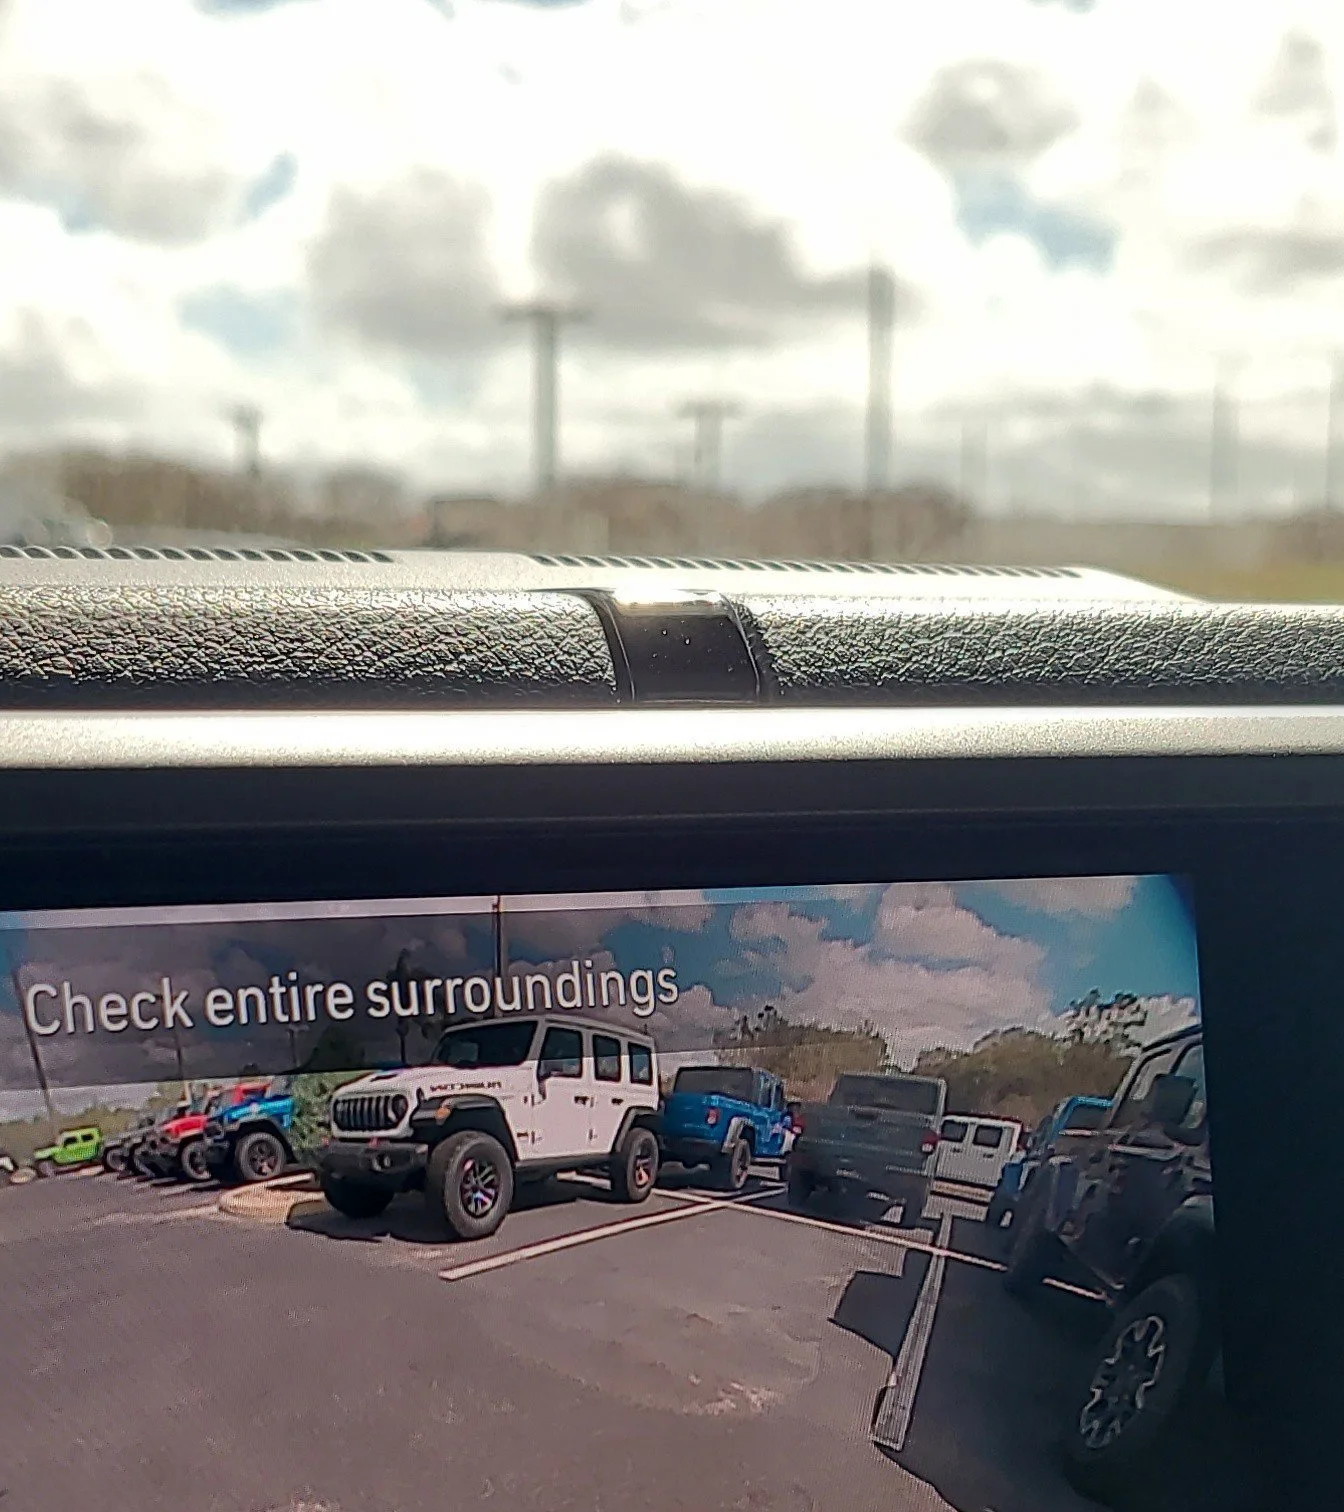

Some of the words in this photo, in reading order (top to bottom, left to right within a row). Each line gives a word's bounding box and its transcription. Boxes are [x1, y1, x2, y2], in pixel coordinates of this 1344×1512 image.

[26, 974, 193, 1036] Check
[207, 970, 354, 1027] entire
[365, 958, 679, 1018] surroundings
